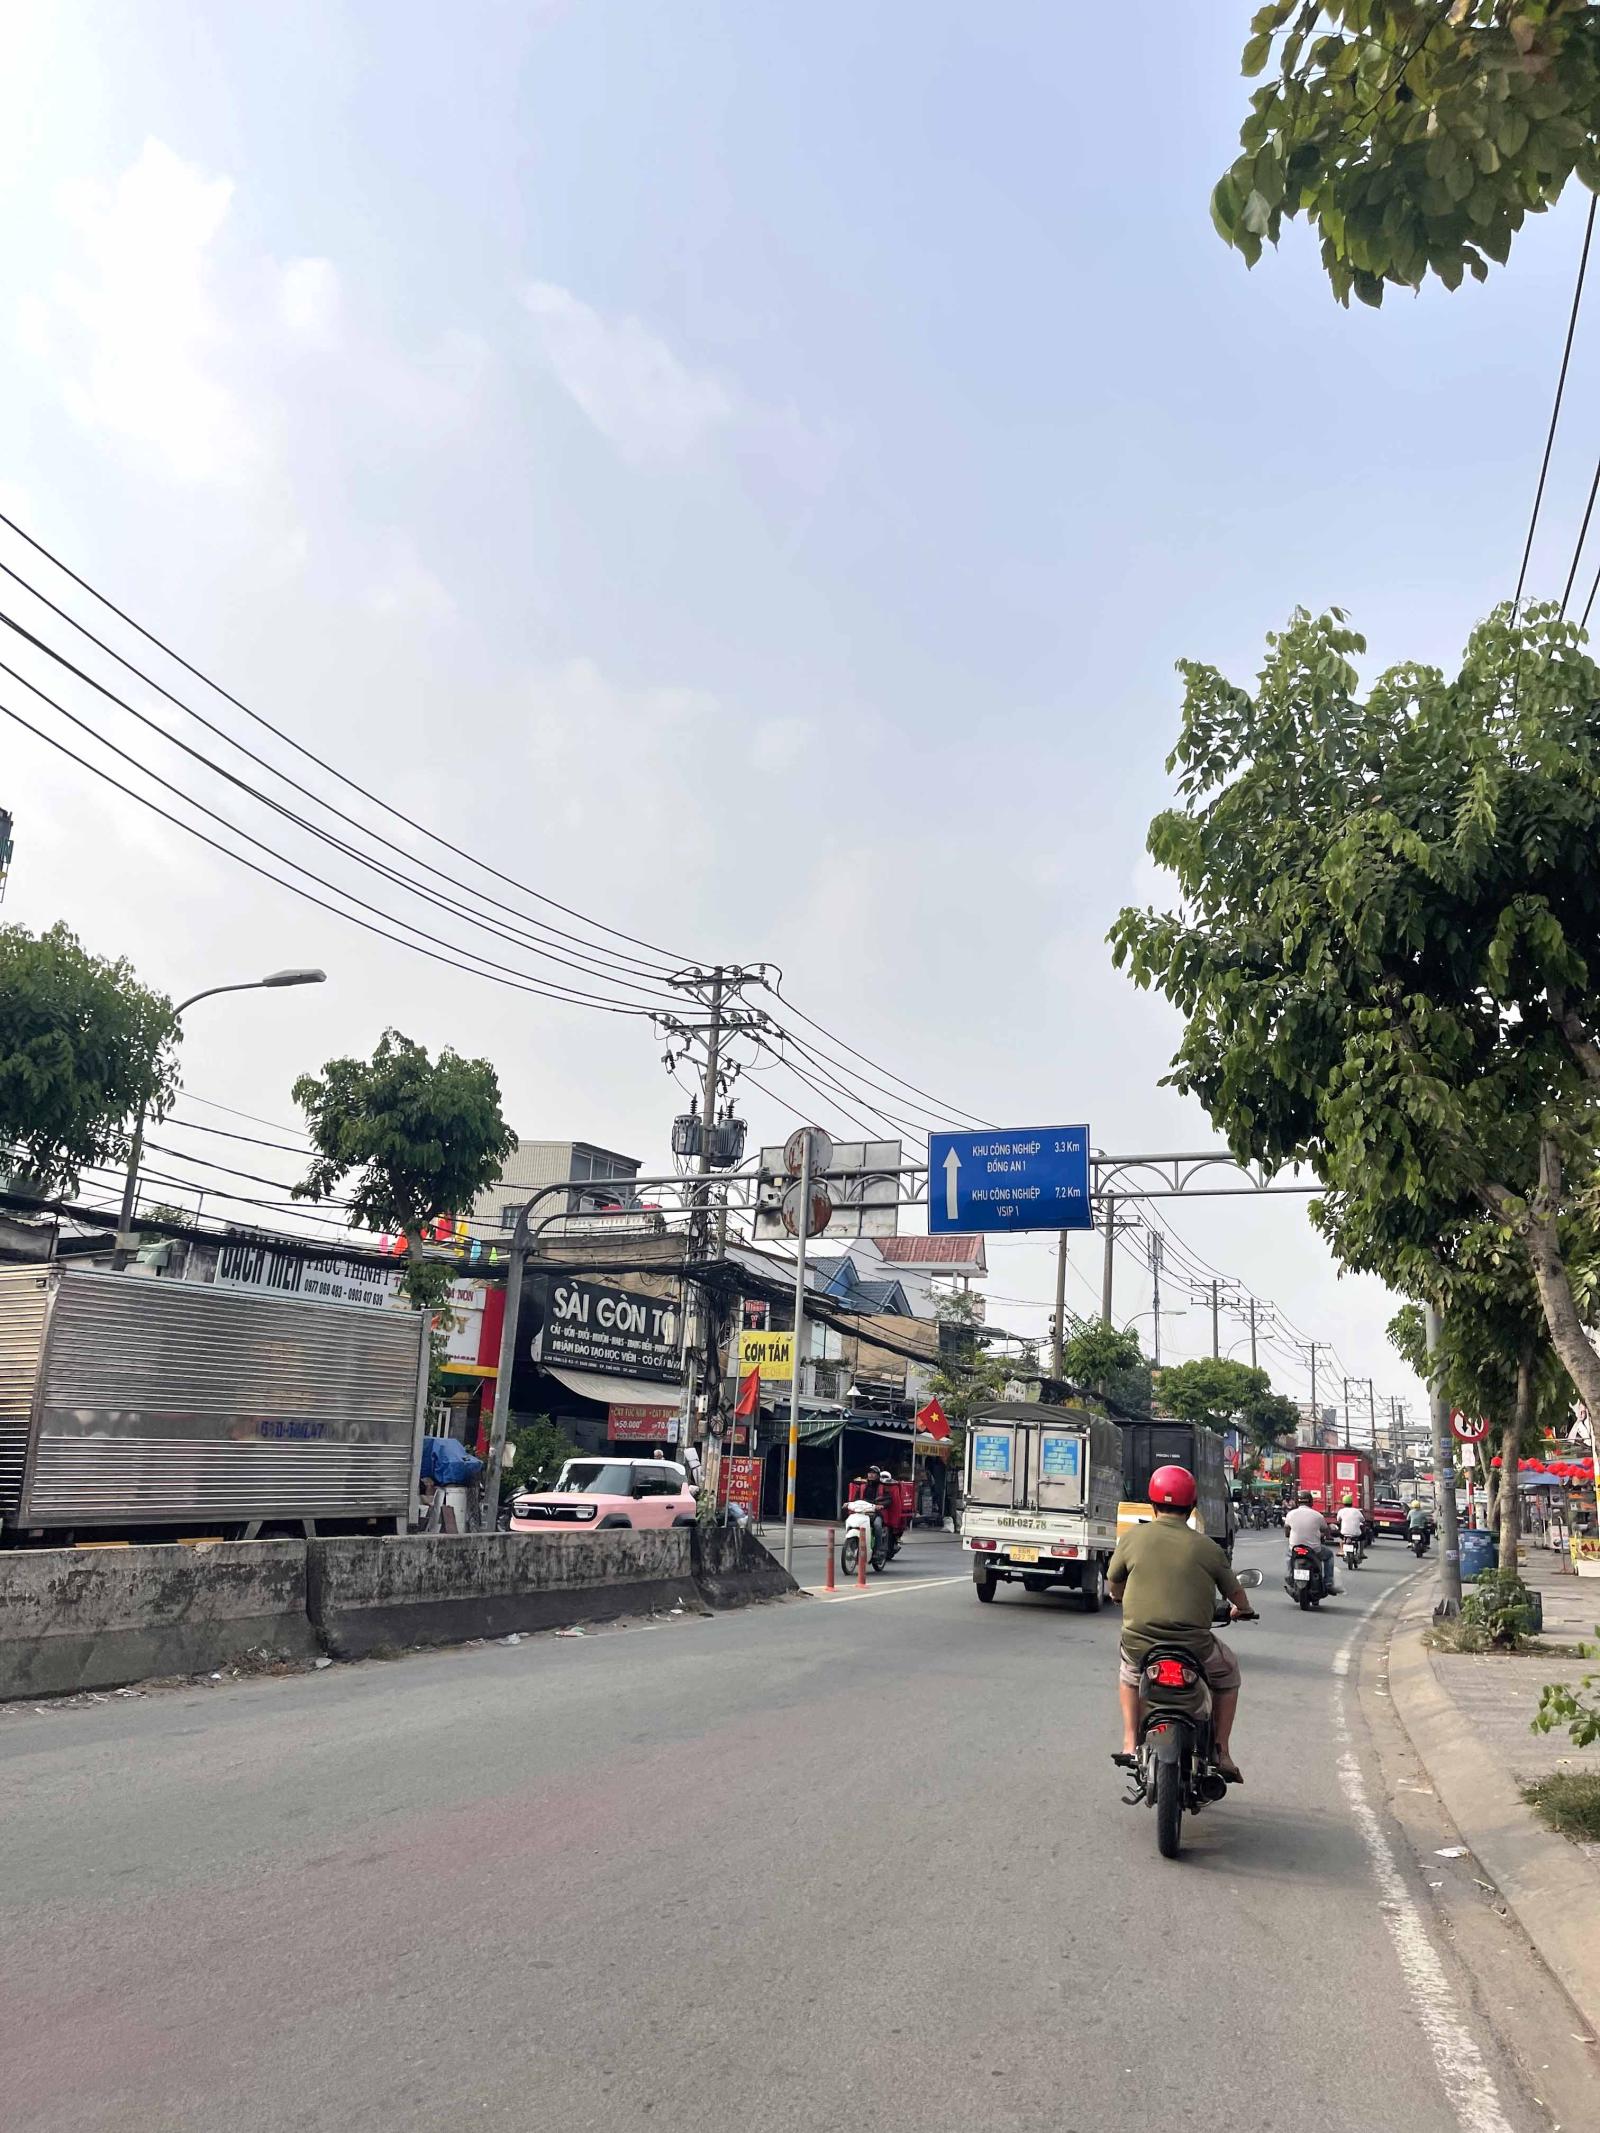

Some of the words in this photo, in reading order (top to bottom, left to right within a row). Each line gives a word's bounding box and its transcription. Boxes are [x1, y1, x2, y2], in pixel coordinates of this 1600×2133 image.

[972, 1145, 988, 1156] KHU
[990, 1144, 1011, 1156] CÔNG
[1012, 1141, 1041, 1156] NGHIỆP
[1054, 1142, 1066, 1152] 3.3
[1066, 1142, 1080, 1152] Km
[987, 1160, 1008, 1172] ĐỒNG
[1010, 1162, 1022, 1172] AN
[1022, 1162, 1026, 1172] 1
[972, 1190, 988, 1201] KHU
[990, 1188, 1011, 1200] CÔNG
[1012, 1187, 1041, 1200] NGHIỆP
[1067, 1186, 1080, 1198] Km
[996, 1206, 1014, 1216] VSIP
[1016, 1206, 1020, 1216] 1
[304, 1278, 319, 1293] 0977
[319, 1282, 330, 1296] 069
[552, 1282, 590, 1324] SÀI
[596, 1293, 646, 1335] GÒN
[552, 1340, 574, 1354] NHẬN
[574, 1342, 590, 1356] ĐÀO
[590, 1346, 604, 1358] TẠO
[604, 1350, 620, 1362] HỌC
[642, 1354, 653, 1365] CÓ
[745, 1341, 766, 1362] CƠM
[768, 1336, 789, 1362] TẤM
